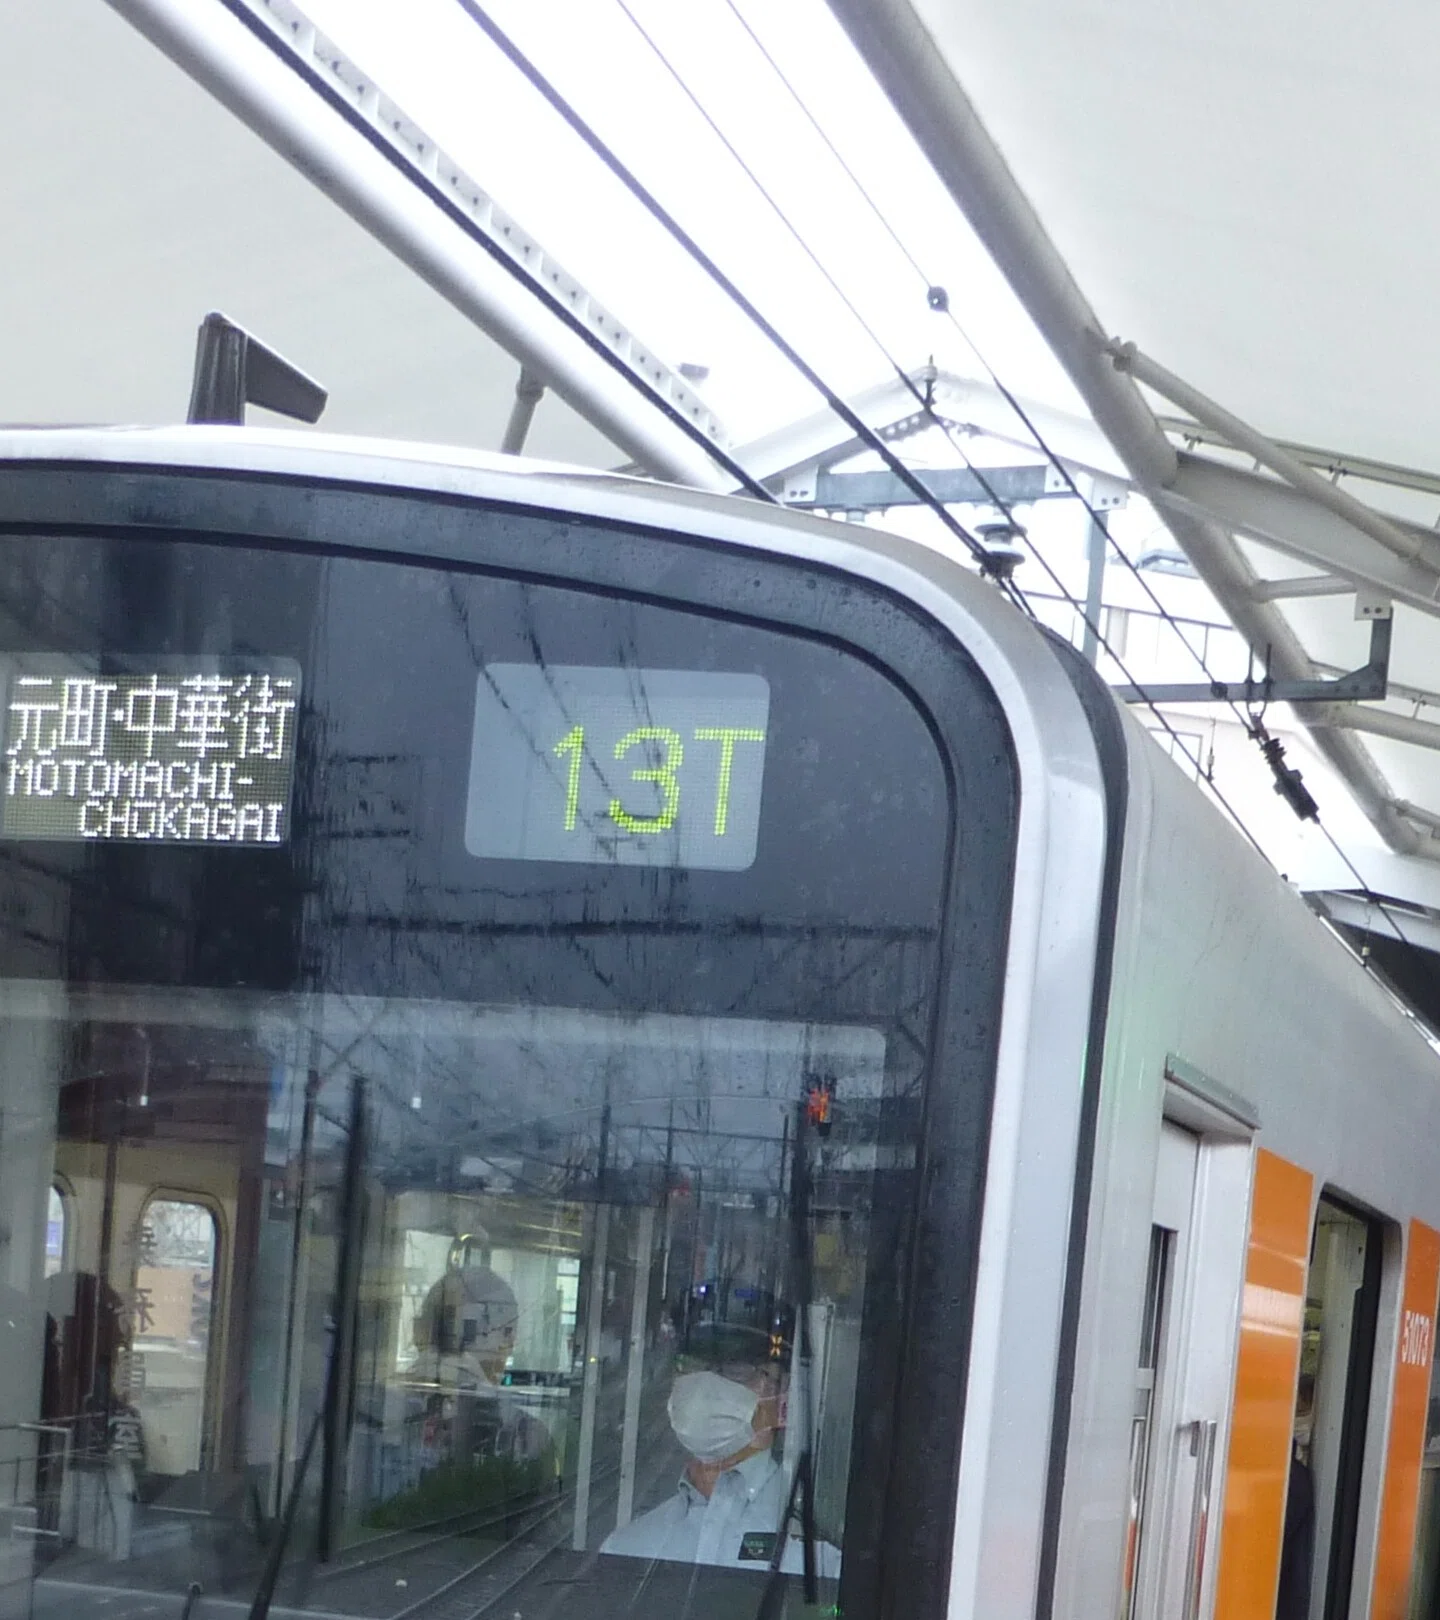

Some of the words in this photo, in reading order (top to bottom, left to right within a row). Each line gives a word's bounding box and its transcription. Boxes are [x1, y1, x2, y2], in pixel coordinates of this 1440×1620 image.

[6, 674, 296, 760] 元町・中華街
[6, 758, 254, 800] MOTOMACHI-
[552, 724, 765, 837] 13T
[1401, 1309, 1431, 1367] 51073
